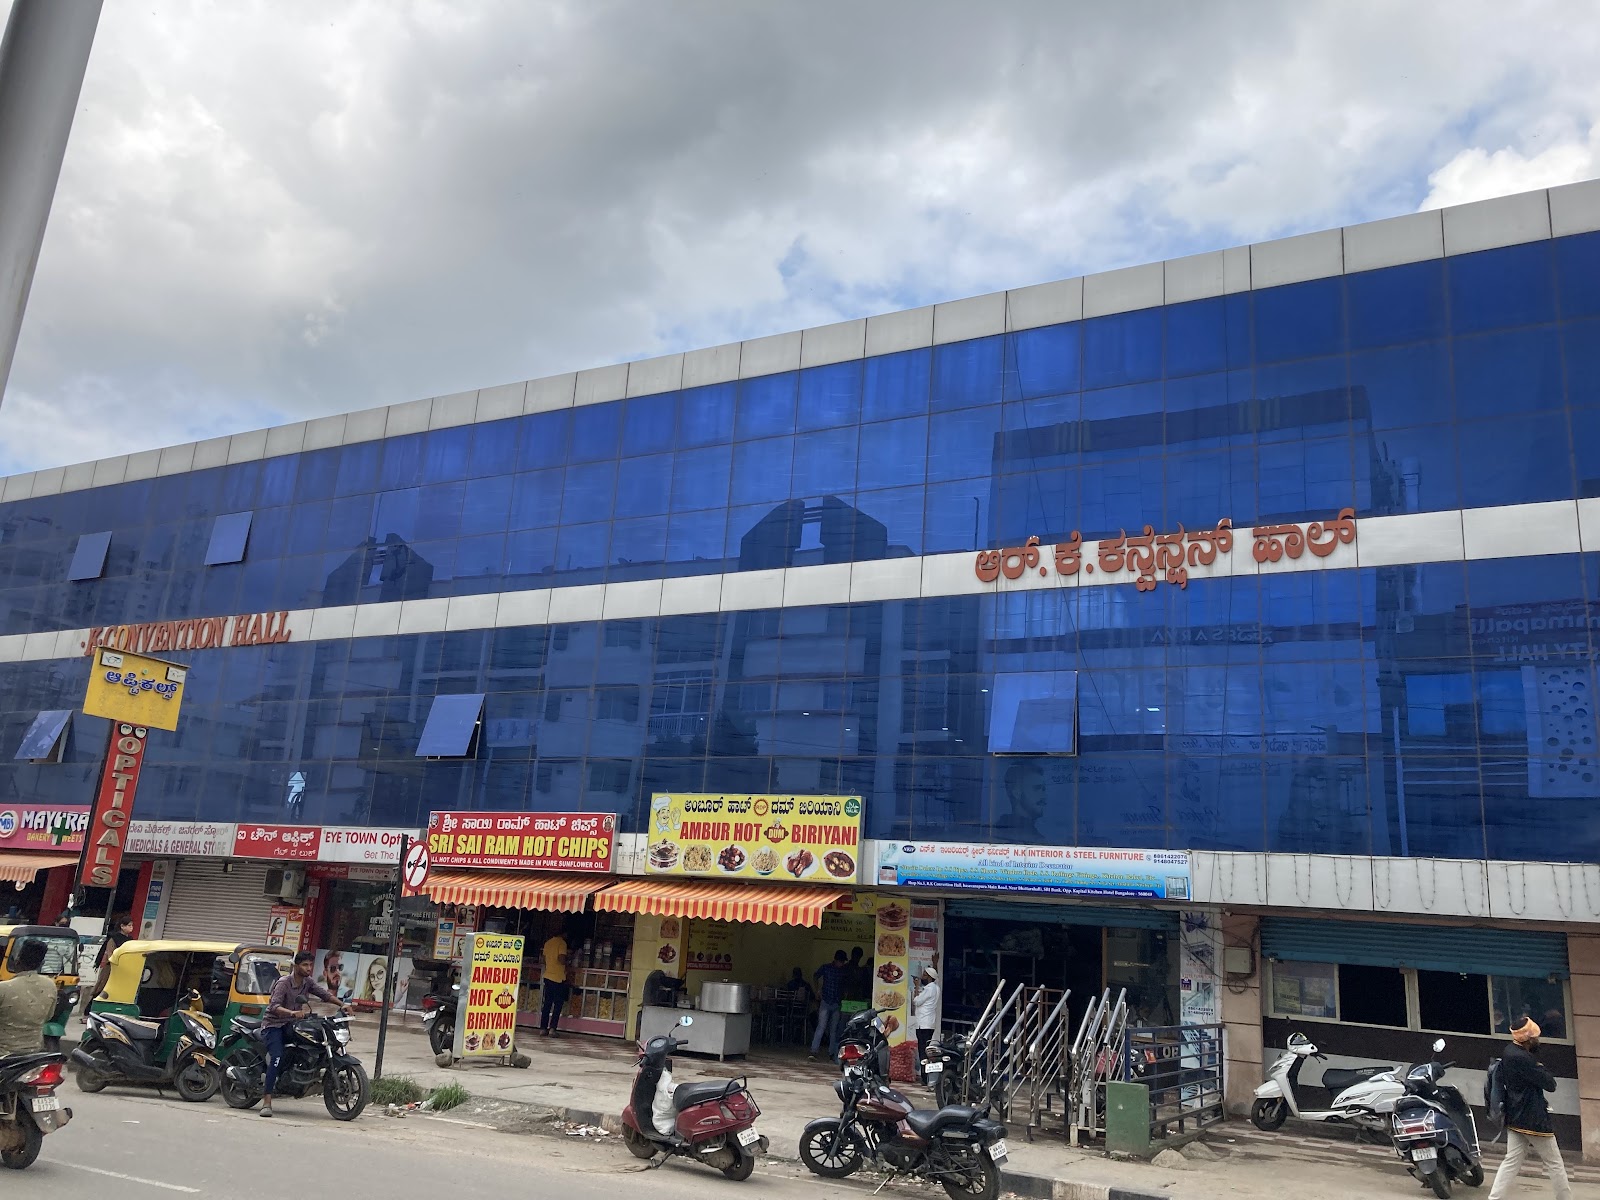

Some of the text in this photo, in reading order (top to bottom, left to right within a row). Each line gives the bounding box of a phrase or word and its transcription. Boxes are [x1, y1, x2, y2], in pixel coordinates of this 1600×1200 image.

[1252, 507, 1355, 564] ಹಾಲ್
[230, 611, 291, 646] HALL
[91, 736, 142, 885] OPTICALS
[325, 831, 342, 843] EYE
[345, 832, 378, 844] TOWN
[679, 821, 858, 846] AMBUR HOT DUM BIRIYANI
[129, 838, 164, 853] MEDICALS
[170, 839, 201, 854] GENERAL
[364, 850, 378, 859] Get
[380, 851, 395, 860] The
[428, 834, 609, 859] SRI SAI RAM HOT CHIPS
[1013, 849, 1144, 861] N.K INTERIOR & STEEL FURNITURE
[558, 860, 593, 868] SUNFLOWER
[594, 861, 604, 869] OIL
[472, 966, 519, 985] AMBUR
[469, 989, 512, 1007] HOT DUM
[466, 1011, 514, 1030] BIRIYANI
